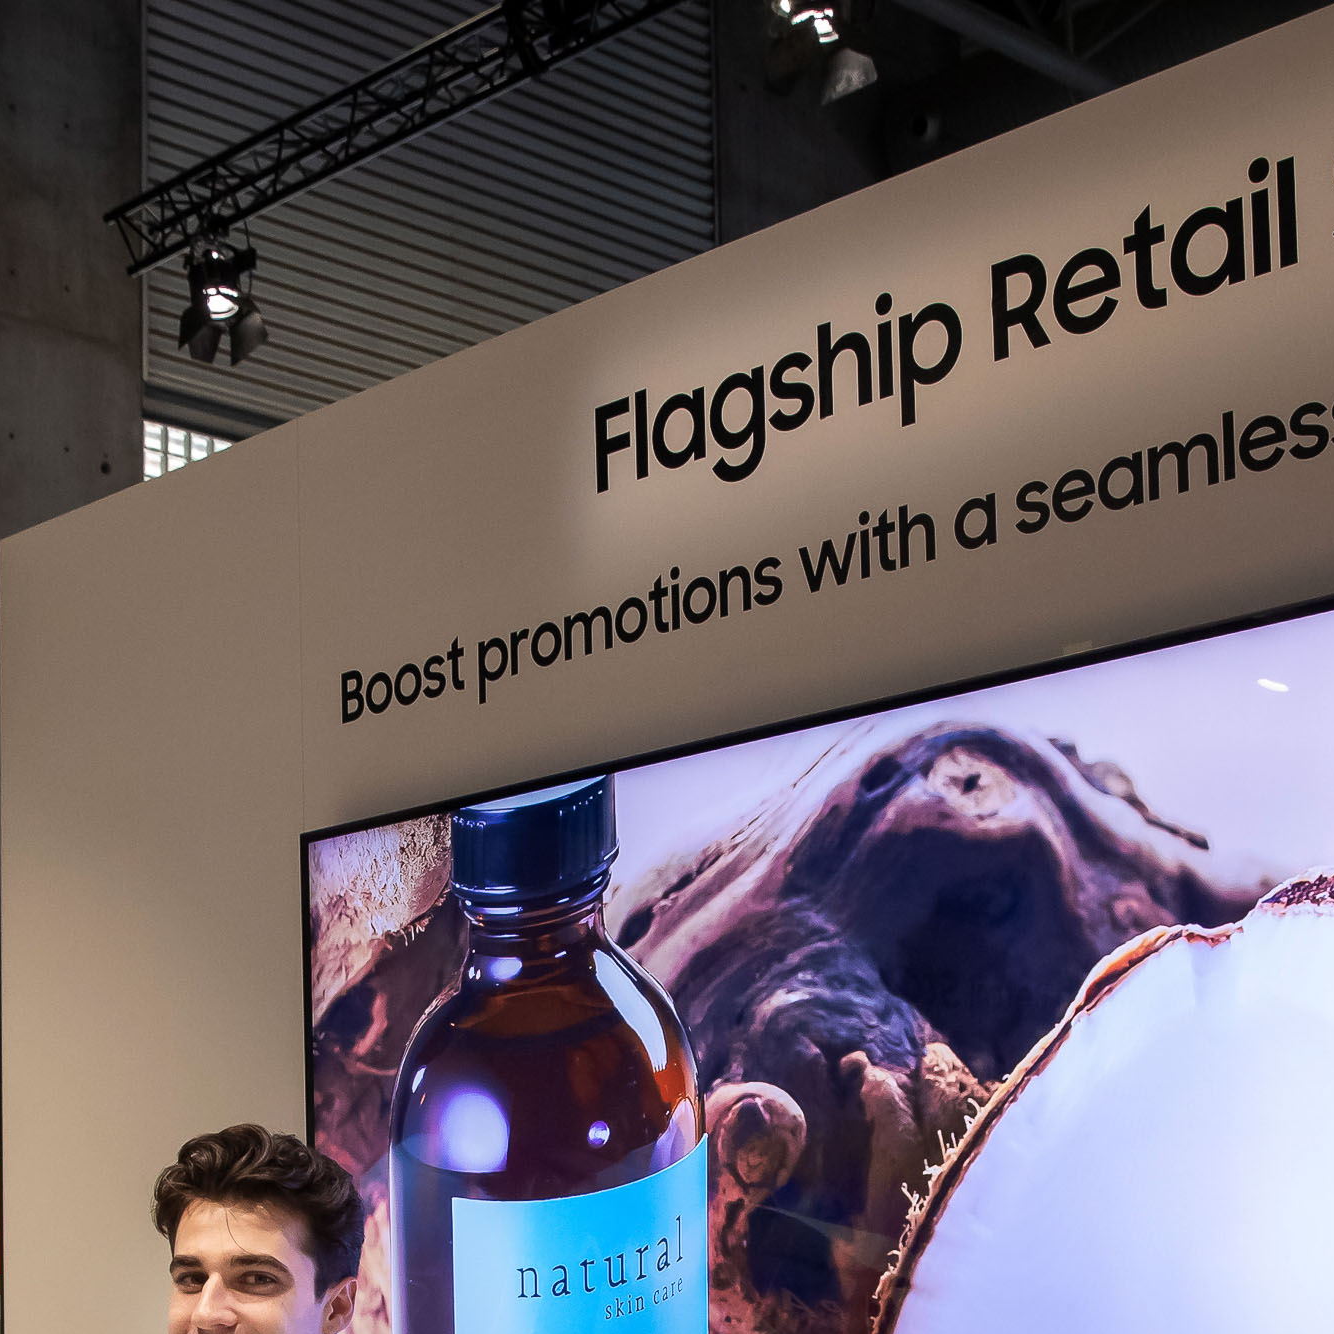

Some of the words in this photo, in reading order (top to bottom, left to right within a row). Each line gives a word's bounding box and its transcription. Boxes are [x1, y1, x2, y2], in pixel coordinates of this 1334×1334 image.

[595, 292, 963, 494] Flagship
[991, 156, 1299, 362] Retail
[341, 636, 465, 724] Boost
[478, 556, 783, 705] promotions
[799, 504, 936, 594] with
[954, 492, 997, 550] a
[516, 1215, 683, 1298] natural
[605, 1294, 645, 1320] skin
[653, 1277, 684, 1305] care
